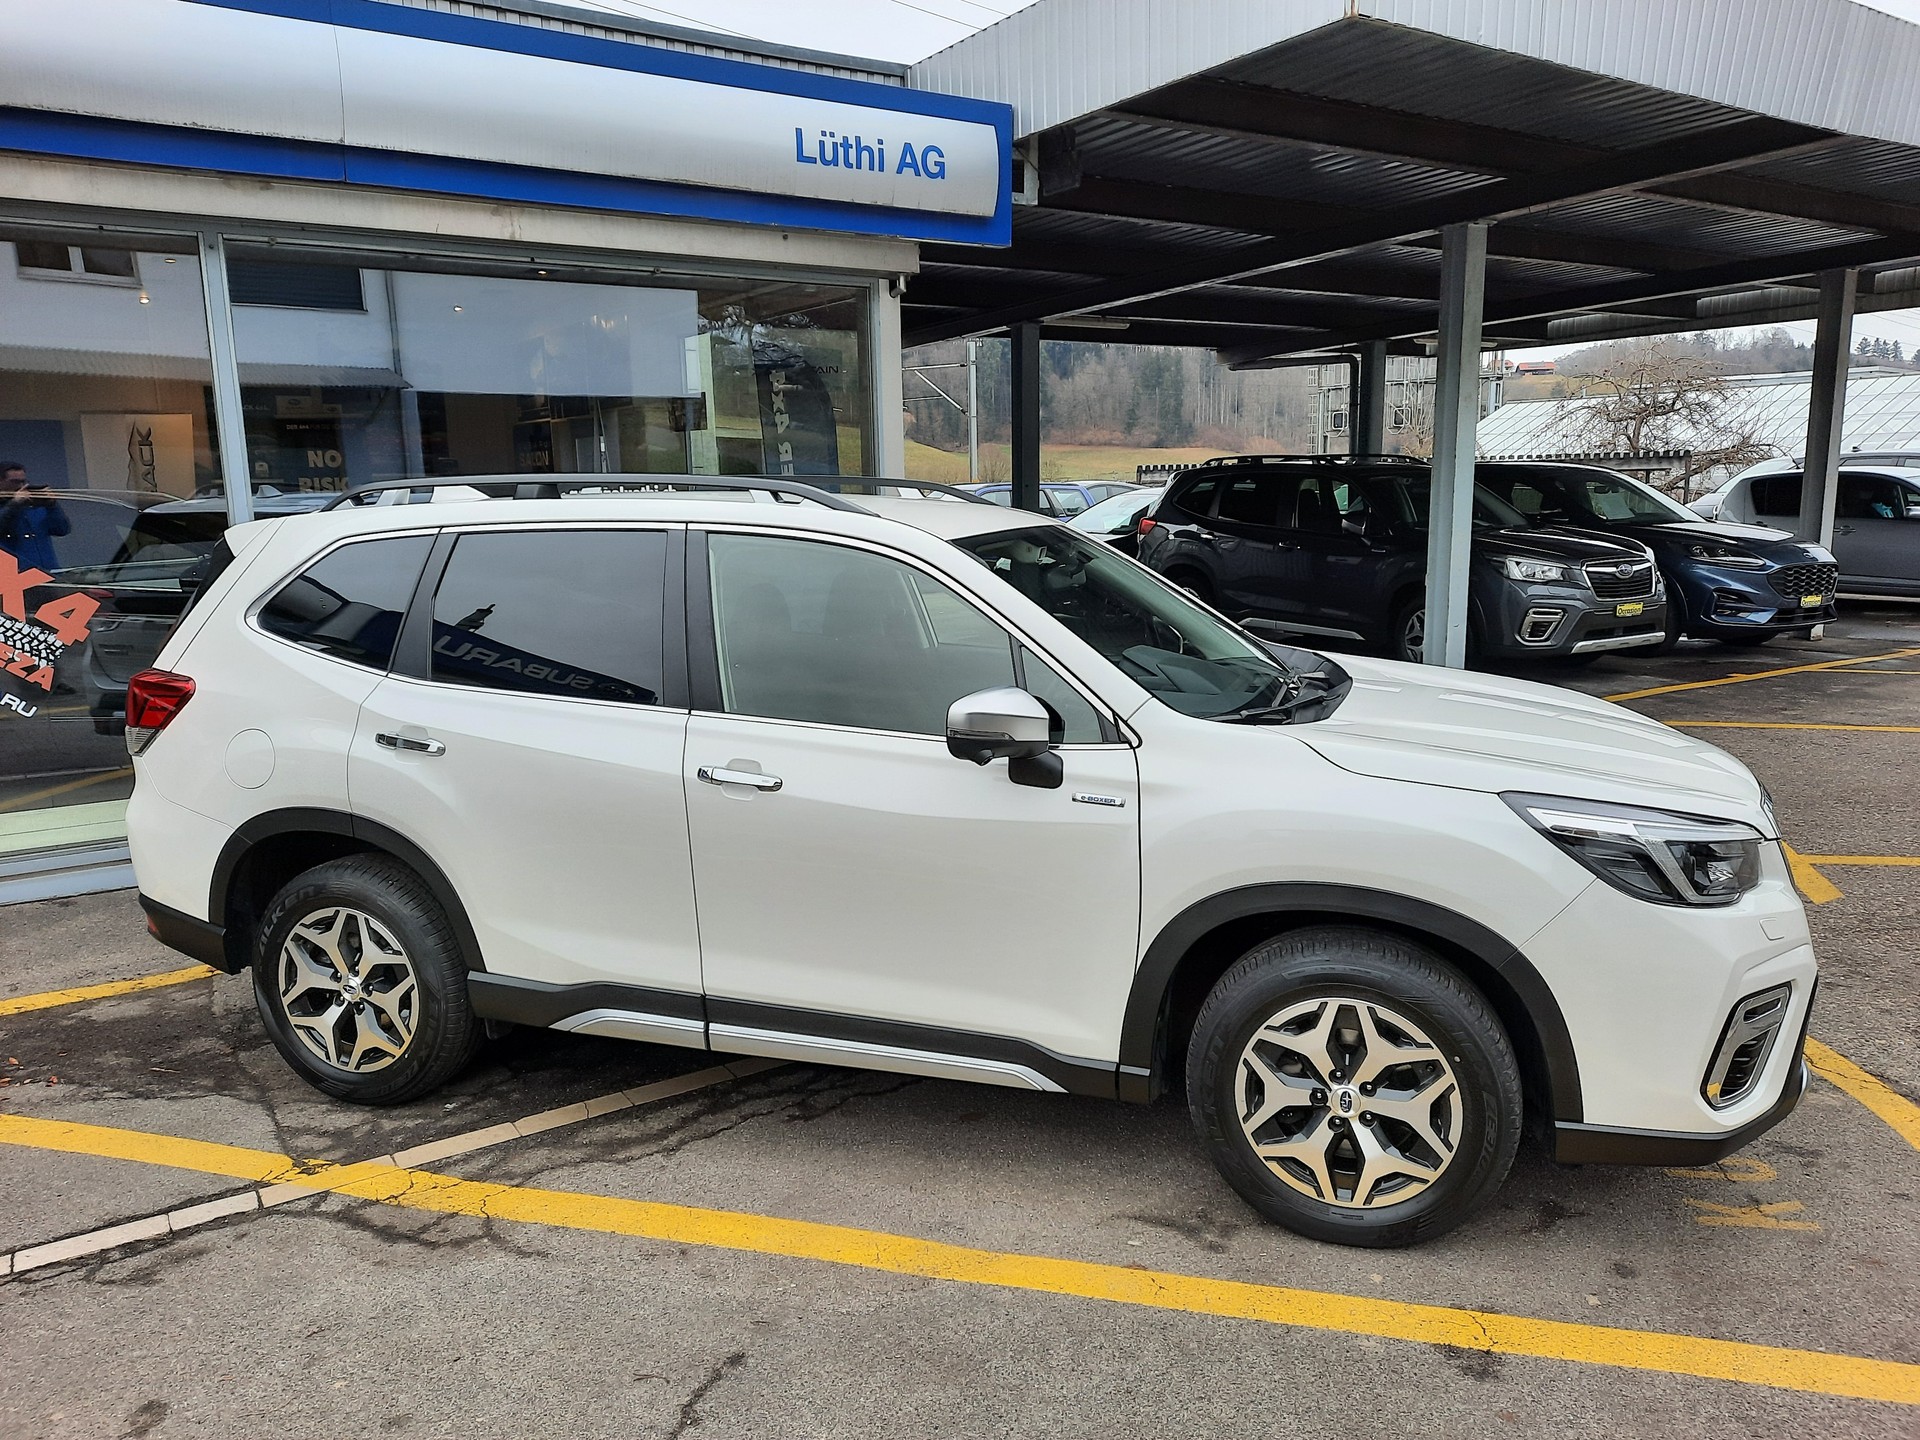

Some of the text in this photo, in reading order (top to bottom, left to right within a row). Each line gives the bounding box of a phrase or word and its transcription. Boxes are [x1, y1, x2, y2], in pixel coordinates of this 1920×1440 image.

[795, 127, 946, 179] Lüthi AG
[307, 449, 342, 468] NO
[298, 477, 349, 492] RISK
